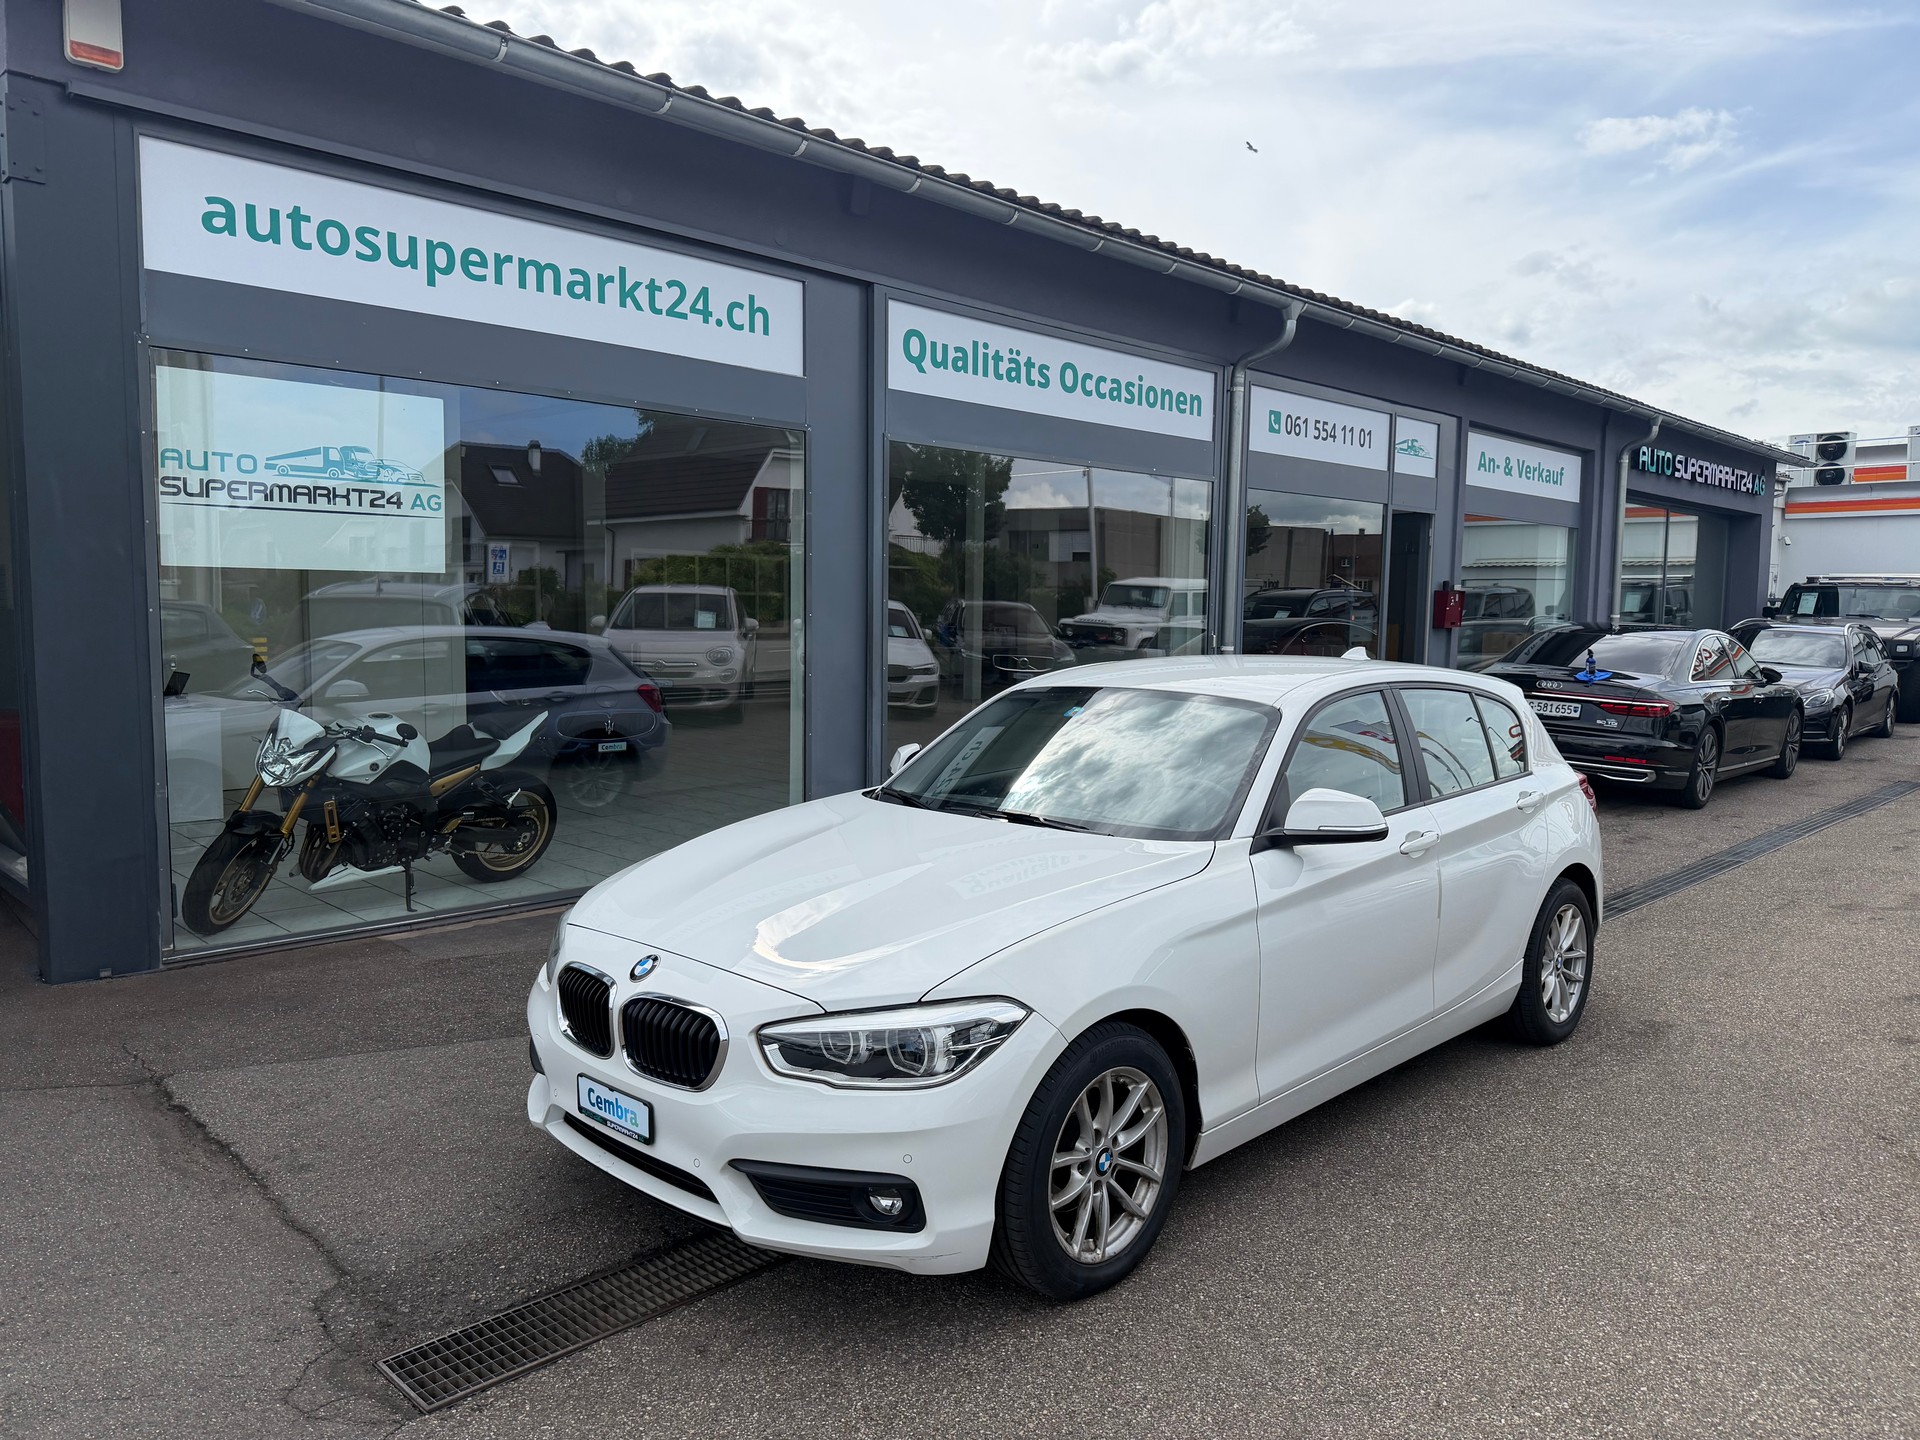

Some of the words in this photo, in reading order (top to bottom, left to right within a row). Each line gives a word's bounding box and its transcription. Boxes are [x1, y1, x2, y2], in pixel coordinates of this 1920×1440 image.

[201, 196, 770, 337] autosupermarkt24.ch
[903, 328, 1051, 389] Qualitäts
[1059, 362, 1202, 417] Occasionen
[1285, 414, 1308, 438] 061
[1313, 419, 1337, 443] 554
[1341, 424, 1354, 446] 11
[1359, 428, 1372, 449] 01
[160, 447, 258, 474] AUTO
[1477, 451, 1500, 474] An-
[1503, 456, 1513, 477] &
[1517, 458, 1565, 486] Verkauf
[1639, 446, 1672, 476] AUTO
[1674, 454, 1753, 494] SUPERMARKT24
[1753, 474, 1766, 496] AG
[160, 476, 403, 510] SUPERMARKT24
[410, 493, 442, 512] AG
[588, 1087, 639, 1128] Cembra
